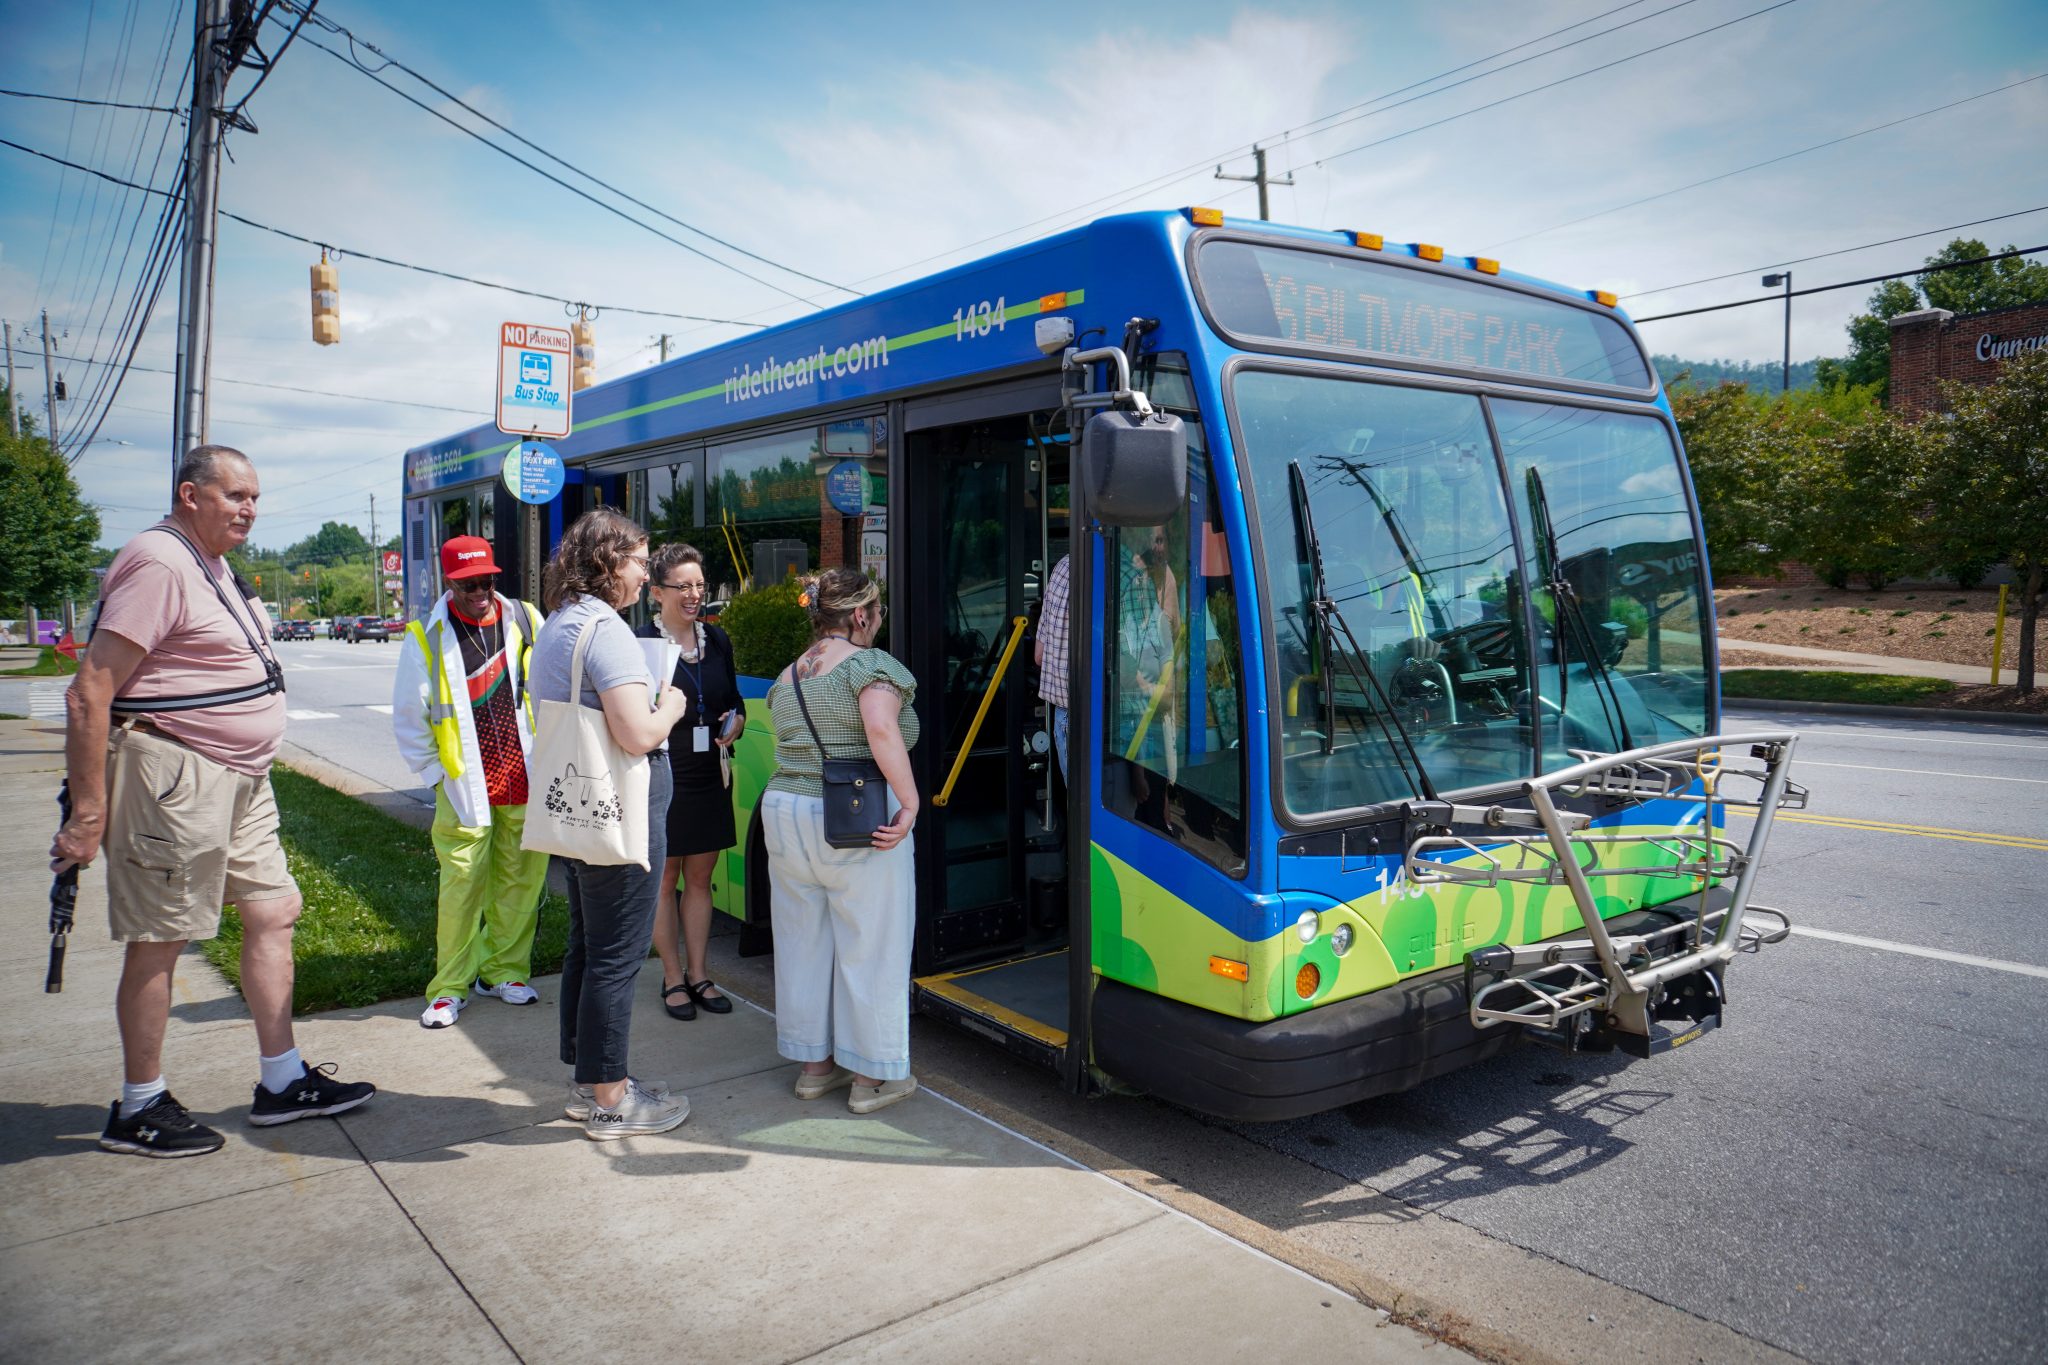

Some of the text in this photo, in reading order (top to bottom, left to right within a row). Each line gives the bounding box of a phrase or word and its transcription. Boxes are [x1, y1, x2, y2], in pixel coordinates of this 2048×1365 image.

[952, 296, 1007, 342] 1434
[1304, 283, 1477, 365] BILTMORE
[1482, 315, 1564, 376] PARK
[504, 325, 568, 348] NO PARKING
[724, 335, 889, 404] ridetheart.com
[514, 384, 560, 406] Bus Stop
[457, 550, 486, 560] Supreme
[593, 1112, 624, 1123] HOKA
